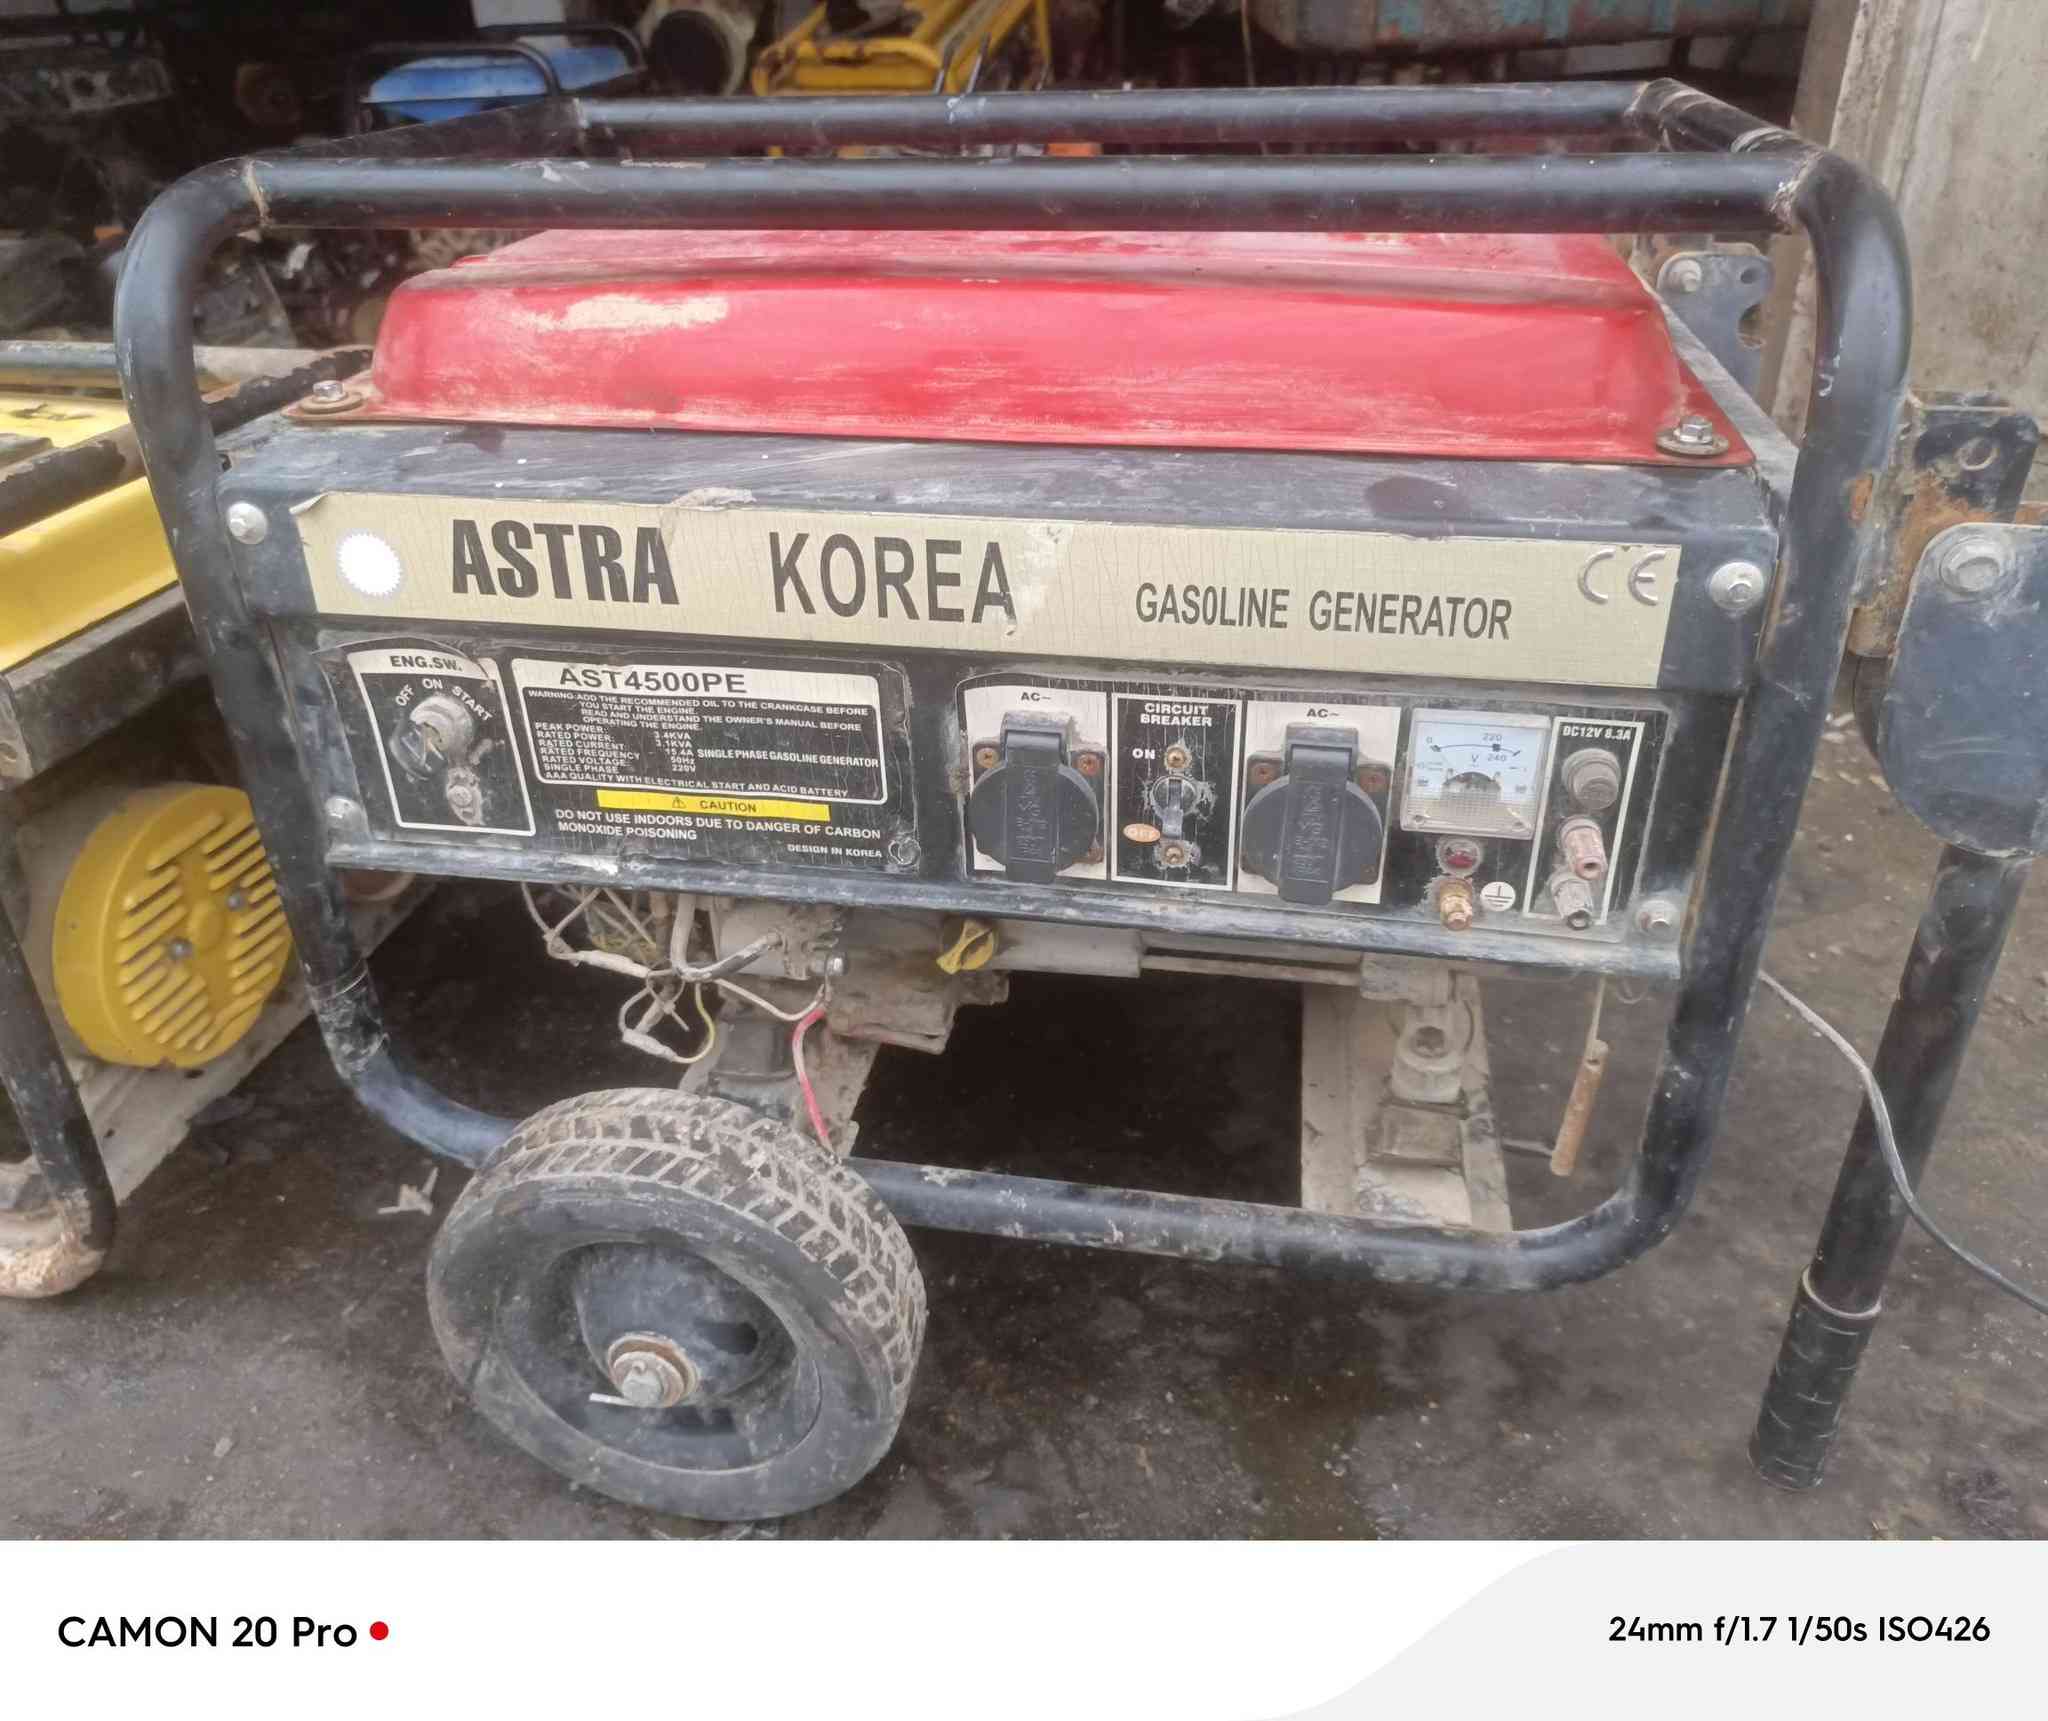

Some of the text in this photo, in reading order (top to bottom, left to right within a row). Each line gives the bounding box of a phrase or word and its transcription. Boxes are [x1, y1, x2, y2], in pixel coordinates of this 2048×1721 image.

[452, 519, 1016, 623] ASTRA KOREA
[1577, 548, 1666, 606] CE
[1136, 582, 1512, 640] GASOLINE GENERATOR
[390, 655, 463, 671] ENG.SW.
[422, 678, 443, 690] ON
[560, 668, 747, 693] AST4500PE
[396, 684, 414, 707] OFF
[451, 686, 493, 721] START
[580, 701, 600, 710] YOU
[601, 703, 632, 712] START
[635, 705, 654, 713] THE
[599, 695, 618, 703] THE
[621, 697, 698, 707] RECOMMENDED
[703, 700, 720, 708] OIL
[722, 700, 736, 708] TO
[739, 701, 758, 709] THE
[760, 702, 823, 713] CRANKCASE
[826, 706, 869, 716] BEFORE
[1144, 702, 1208, 715] CIRCUIT
[535, 722, 562, 731] PEAK
[581, 709, 862, 731] READ AND UNDERSTAND THE OWNER'S MANUAL BEFORE
[582, 716, 640, 728] OPERATING
[641, 721, 658, 729] THE
[1140, 713, 1212, 727] BREAKER
[537, 730, 572, 739] RATED
[1482, 733, 1503, 742] 220
[1562, 725, 1603, 738] DC12V
[538, 739, 573, 748] RATED
[540, 747, 575, 756] RATED
[578, 749, 640, 760] FREQUENCY
[542, 755, 577, 764] RATED
[697, 748, 879, 768] SINGLE PHASE GASOLINE GENERATOR
[1132, 748, 1155, 759] ON
[544, 763, 619, 774] SINGLE PHASE
[570, 773, 613, 782] QUALITY
[616, 776, 642, 784] WITH
[645, 777, 711, 789] ELECTRICAL
[712, 781, 745, 790] START
[748, 783, 770, 792] AND
[772, 784, 797, 793] ACID
[800, 787, 848, 798] BATTERY
[700, 800, 757, 813] CAUTION
[555, 809, 881, 840] DO NOT USE INDOORS DUE TO DANGER OF CARBON
[558, 822, 697, 840] MONOXIDE POISONING
[787, 844, 882, 858] DESIGN IN KOREA
